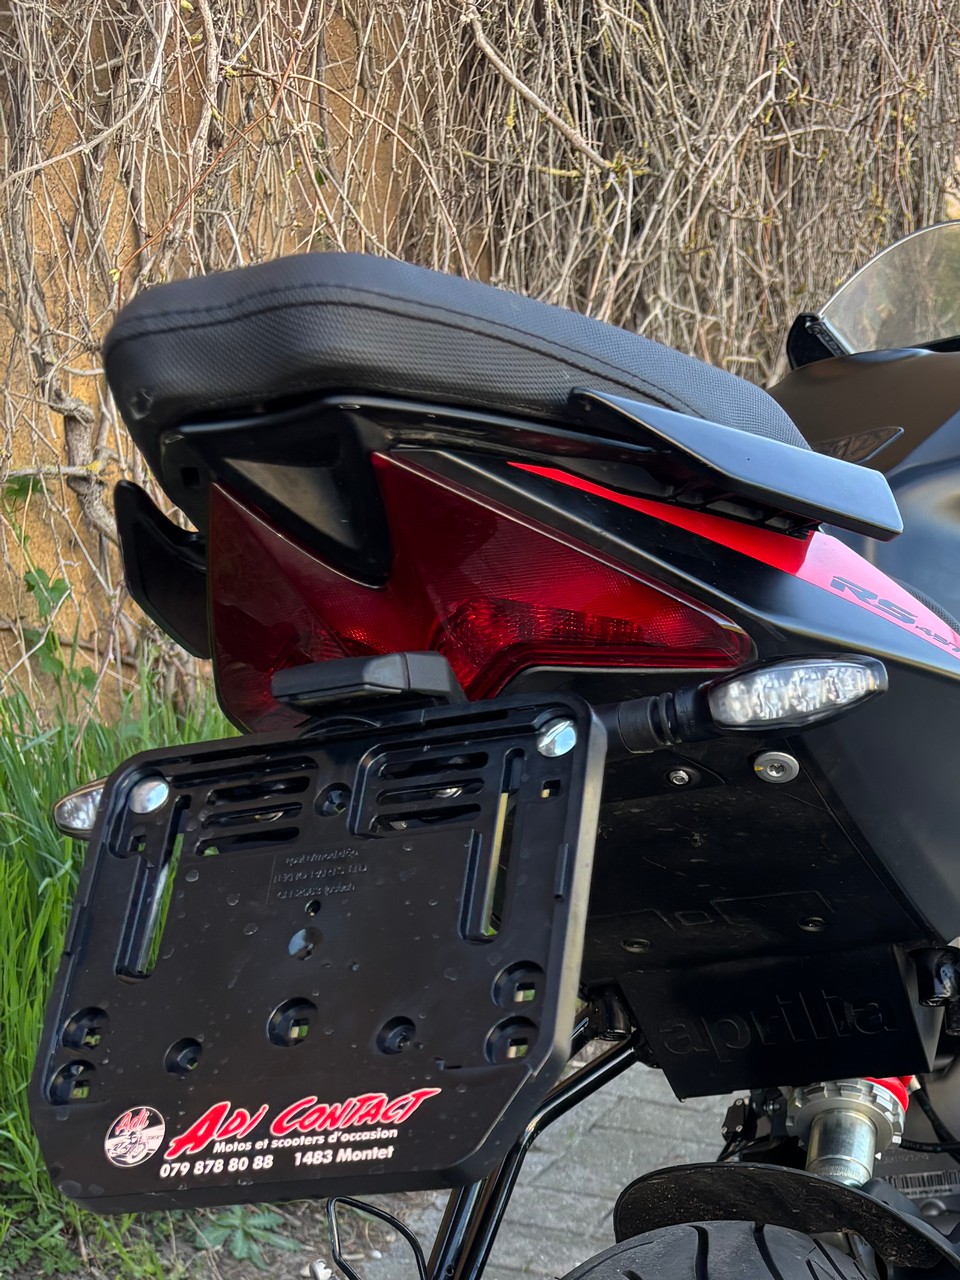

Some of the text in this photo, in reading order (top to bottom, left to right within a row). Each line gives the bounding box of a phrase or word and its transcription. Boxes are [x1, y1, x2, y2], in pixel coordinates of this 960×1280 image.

[829, 576, 918, 625] RS
[659, 989, 899, 1063] aprilia
[115, 1108, 149, 1135] Adi
[270, 1088, 442, 1137] CONTACT
[213, 1127, 398, 1154] Motos et scooters d'occasion
[159, 1145, 395, 1178] 079 878 80 88 1483 Montet
